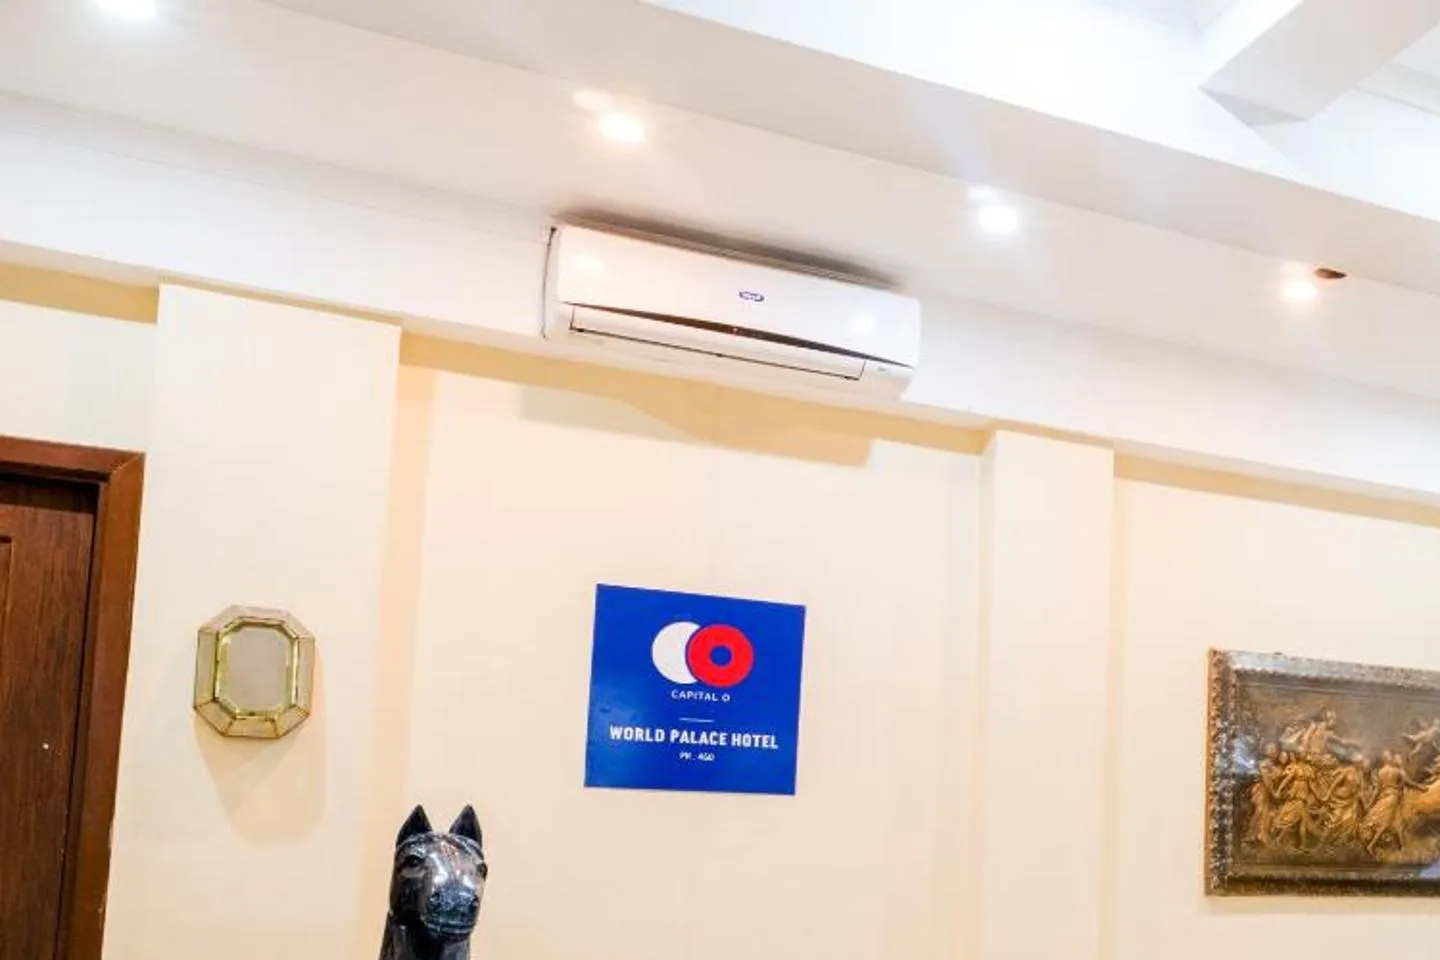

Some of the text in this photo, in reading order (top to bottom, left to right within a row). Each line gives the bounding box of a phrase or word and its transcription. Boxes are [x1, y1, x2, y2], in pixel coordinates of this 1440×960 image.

[671, 689, 731, 702] CAPITAL O
[609, 725, 779, 749] WORLD PALACE HOTEL
